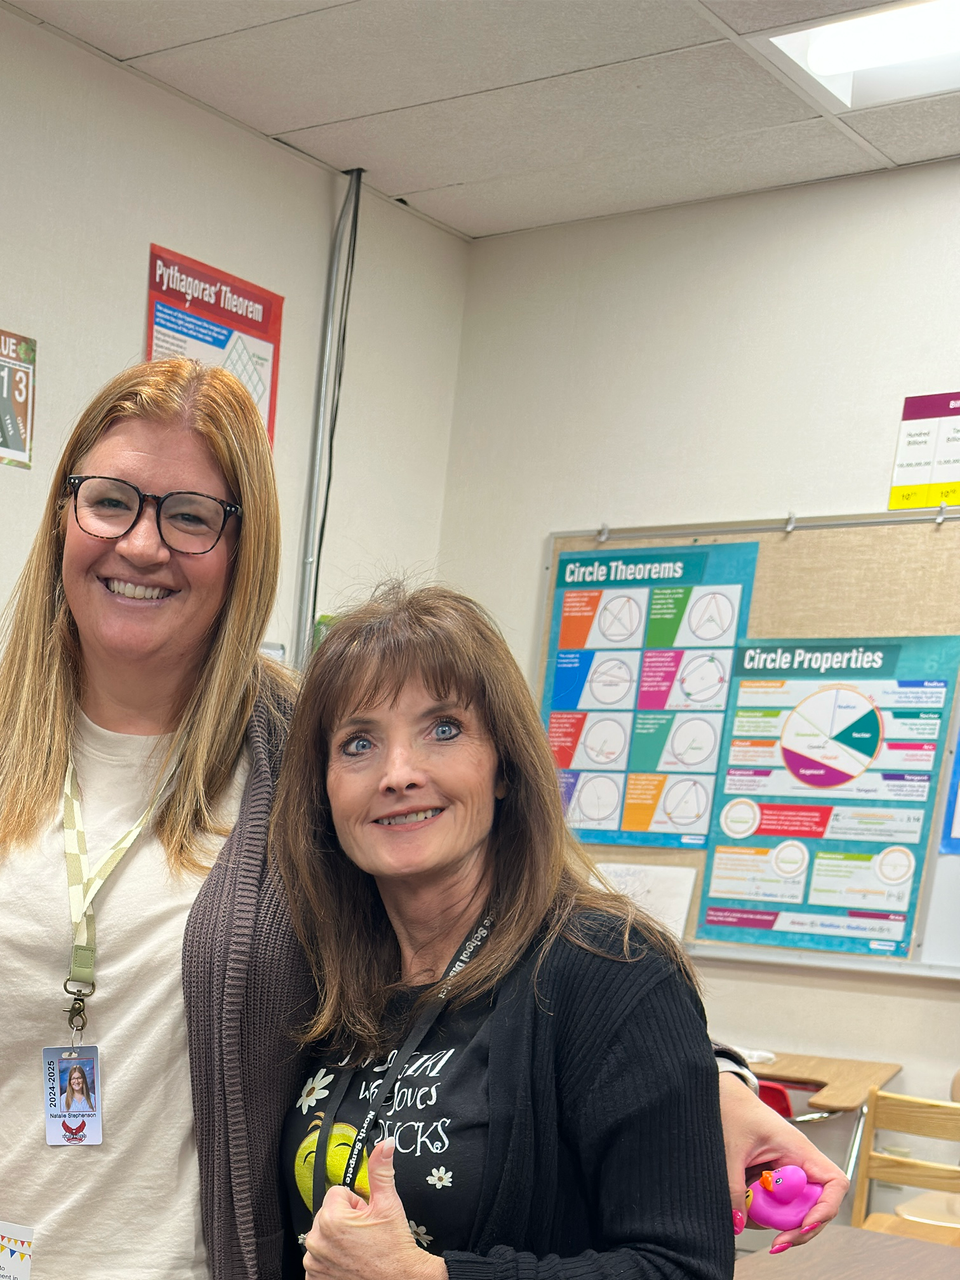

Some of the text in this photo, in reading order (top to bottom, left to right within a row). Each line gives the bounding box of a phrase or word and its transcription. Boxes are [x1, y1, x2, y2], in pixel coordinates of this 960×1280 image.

[155, 259, 264, 323] Pythagoras' Theorem
[4, 414, 15, 436] TENS
[564, 560, 684, 583] Circle Theorems
[743, 647, 883, 674] Circle Properties
[460, 926, 488, 962] School
[47, 1060, 57, 1108] 2024-2025
[386, 1081, 441, 1116] loves
[345, 1110, 376, 1184] North Sanpete
